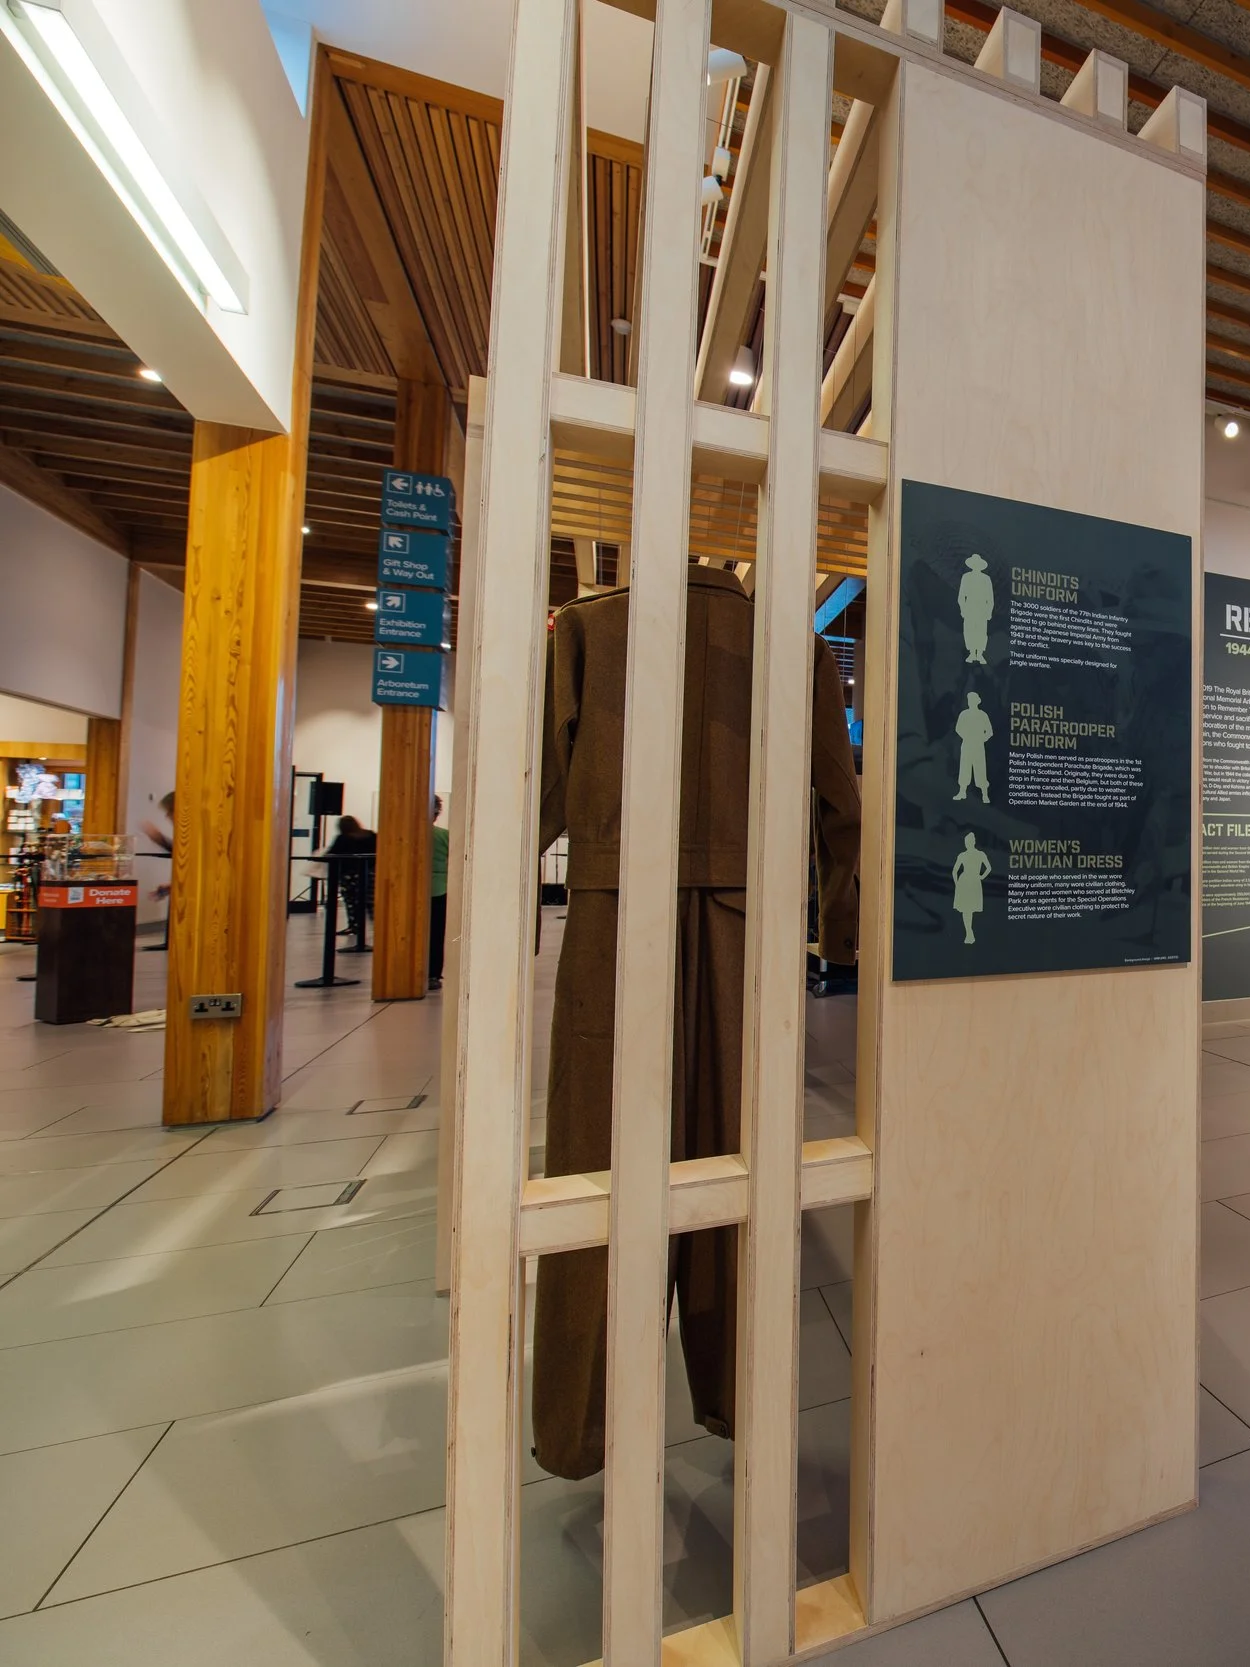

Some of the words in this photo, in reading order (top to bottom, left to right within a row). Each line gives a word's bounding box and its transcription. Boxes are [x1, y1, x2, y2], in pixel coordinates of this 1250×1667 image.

[386, 499, 416, 510] Toilets
[419, 504, 426, 512] &
[386, 508, 410, 518] Cash
[413, 511, 437, 522] Point
[383, 559, 401, 567] Gift
[403, 560, 428, 571] Shop
[392, 569, 413, 579] Way
[416, 571, 434, 580] Out
[1011, 567, 1079, 589] CHINDITS
[1011, 581, 1078, 604] UNIFORM
[1010, 600, 1022, 608] The
[1022, 602, 1039, 610] 3000
[1039, 605, 1061, 613] soldiers
[1108, 614, 1128, 624] Infantry
[1010, 608, 1033, 617] Brigade
[1070, 616, 1092, 625] Chindits
[380, 619, 426, 628] Exhibition
[1010, 616, 1030, 624] trained
[1046, 621, 1066, 629] behind
[1066, 624, 1086, 633] enemy
[1101, 628, 1114, 636] They
[1114, 630, 1132, 638] fought
[380, 628, 421, 637] Entrance
[1009, 624, 1031, 632] against
[1042, 628, 1069, 637] Japanese
[1069, 631, 1091, 640] Imperial
[1091, 634, 1106, 642] Army
[1010, 631, 1024, 639] 1943
[1050, 636, 1072, 645] bravery
[1084, 640, 1094, 648] key
[1110, 644, 1131, 652] success
[1009, 650, 1025, 658] Their
[1060, 658, 1084, 666] specially
[1084, 660, 1109, 668] designed
[1009, 659, 1027, 667] jungle
[378, 679, 429, 689] Arboretum
[1213, 685, 1224, 694] The
[1225, 687, 1241, 696] Royal
[377, 688, 419, 698] Entrance
[1216, 695, 1242, 704] Memorial
[1011, 702, 1063, 719] POLISH
[1217, 704, 1248, 714] Remember
[1011, 718, 1115, 737] PARATROOPER
[1010, 733, 1077, 749] UNIFORM
[1009, 751, 1025, 760] Many
[1009, 855, 1072, 868] CIVILIAN
[1077, 855, 1123, 868] DRESS
